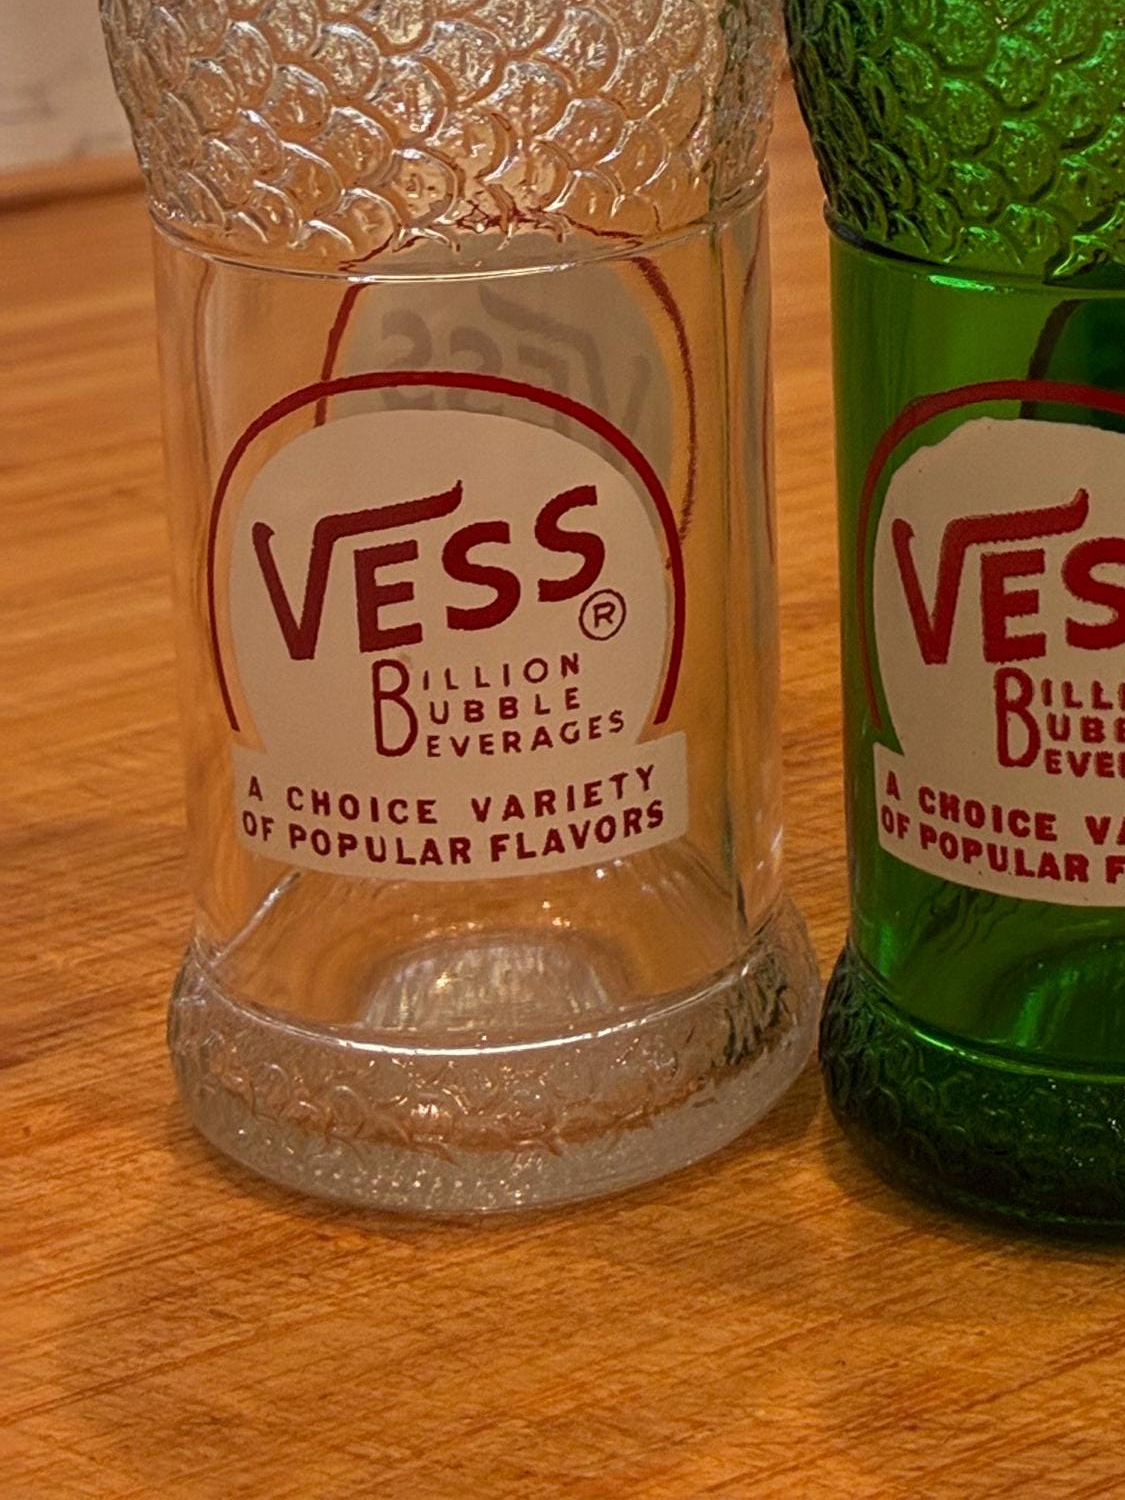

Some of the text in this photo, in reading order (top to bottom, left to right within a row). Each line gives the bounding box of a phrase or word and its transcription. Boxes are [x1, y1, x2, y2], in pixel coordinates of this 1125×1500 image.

[252, 479, 607, 661] VESS
[247, 764, 656, 826] A CHOICE VARIETY
[885, 770, 901, 801] A
[917, 786, 1059, 842] CHOICE
[241, 799, 665, 867] OF POPULAR FLAVORS
[880, 804, 912, 839] OF
[918, 823, 1091, 884] POPULAR
